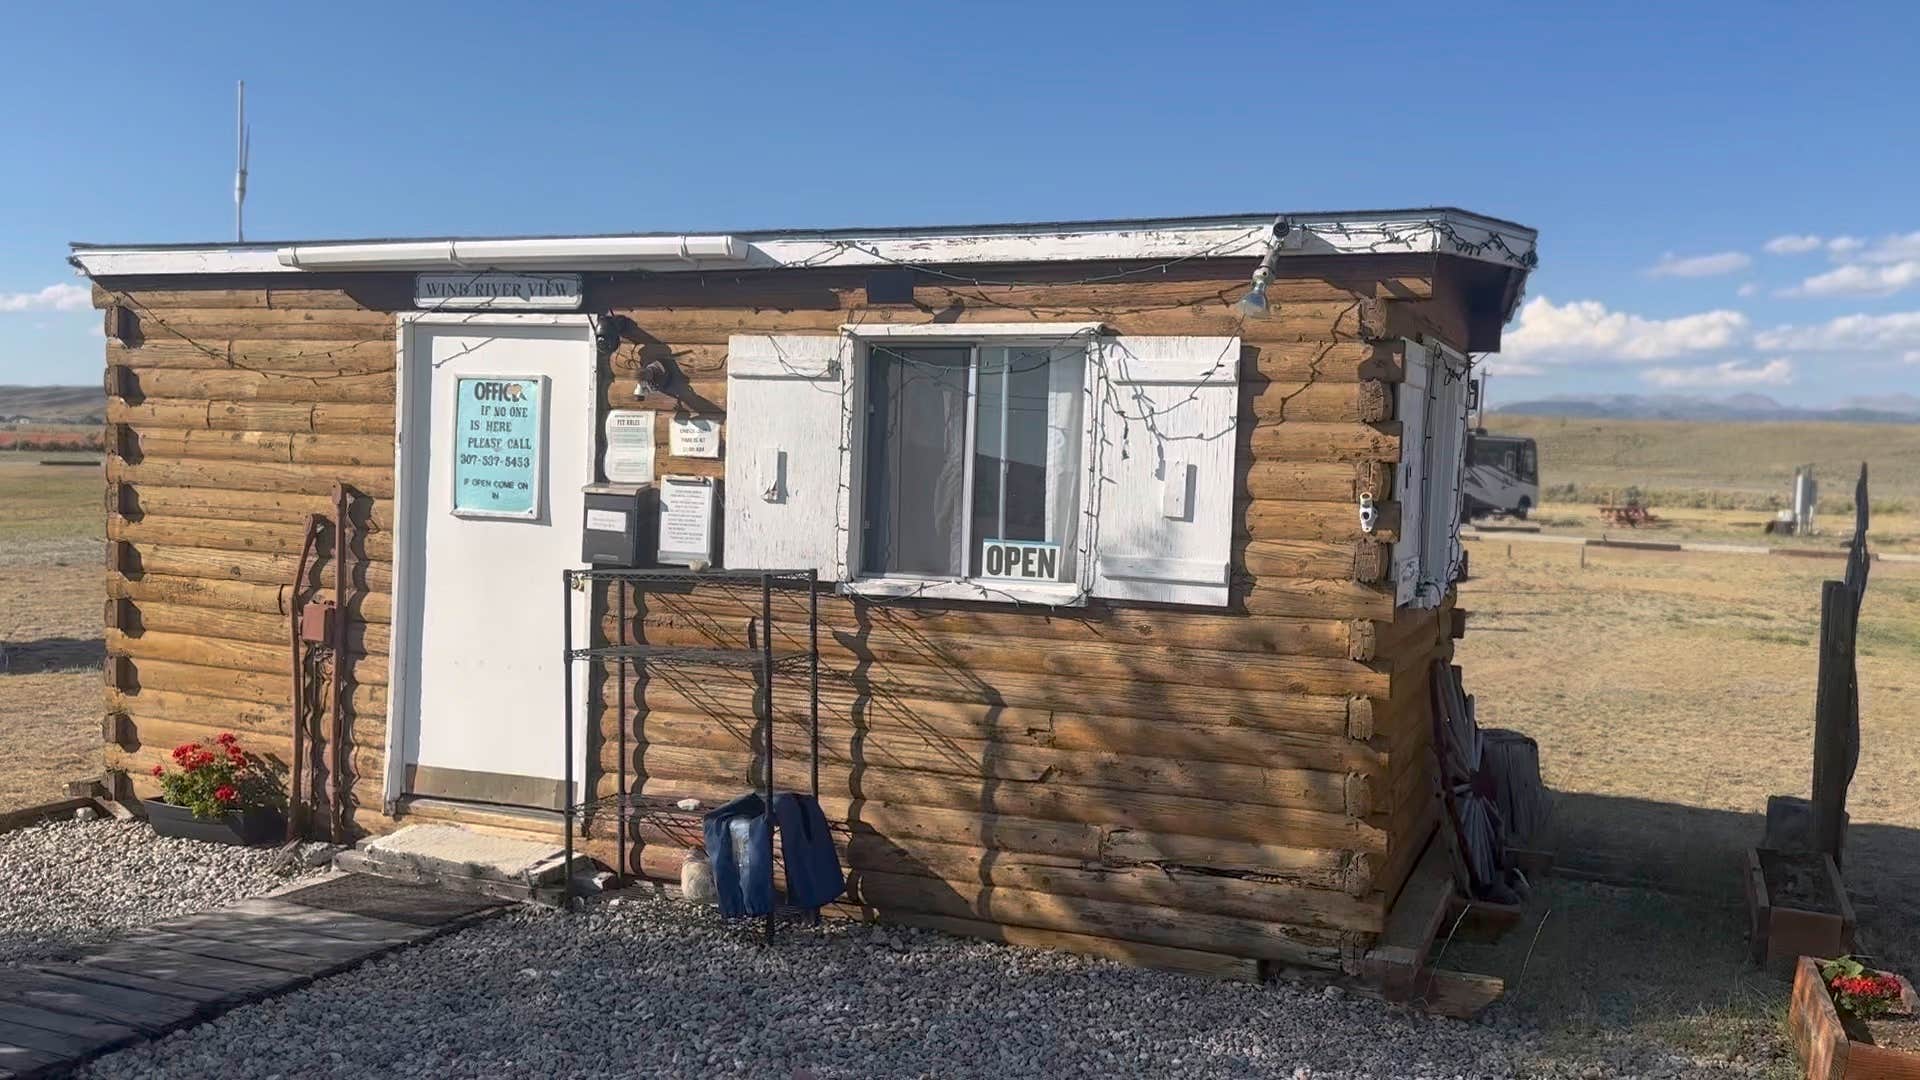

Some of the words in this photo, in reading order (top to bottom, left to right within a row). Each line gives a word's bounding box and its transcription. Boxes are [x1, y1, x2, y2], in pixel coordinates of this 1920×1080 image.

[426, 282, 469, 297] WIND
[475, 282, 521, 297] RIVER
[527, 281, 568, 297] VIEW
[481, 405, 491, 416] IF
[494, 406, 506, 417] NO
[509, 407, 528, 418] ONE
[470, 420, 480, 431] IS
[486, 421, 512, 432] HERE
[468, 437, 502, 449] PLEASE
[507, 438, 532, 450] CALL
[471, 479, 491, 487] OPEN
[493, 480, 514, 489] COME
[517, 482, 529, 490] ON
[492, 492, 499, 500] IN
[986, 545, 1057, 579] OPEN
